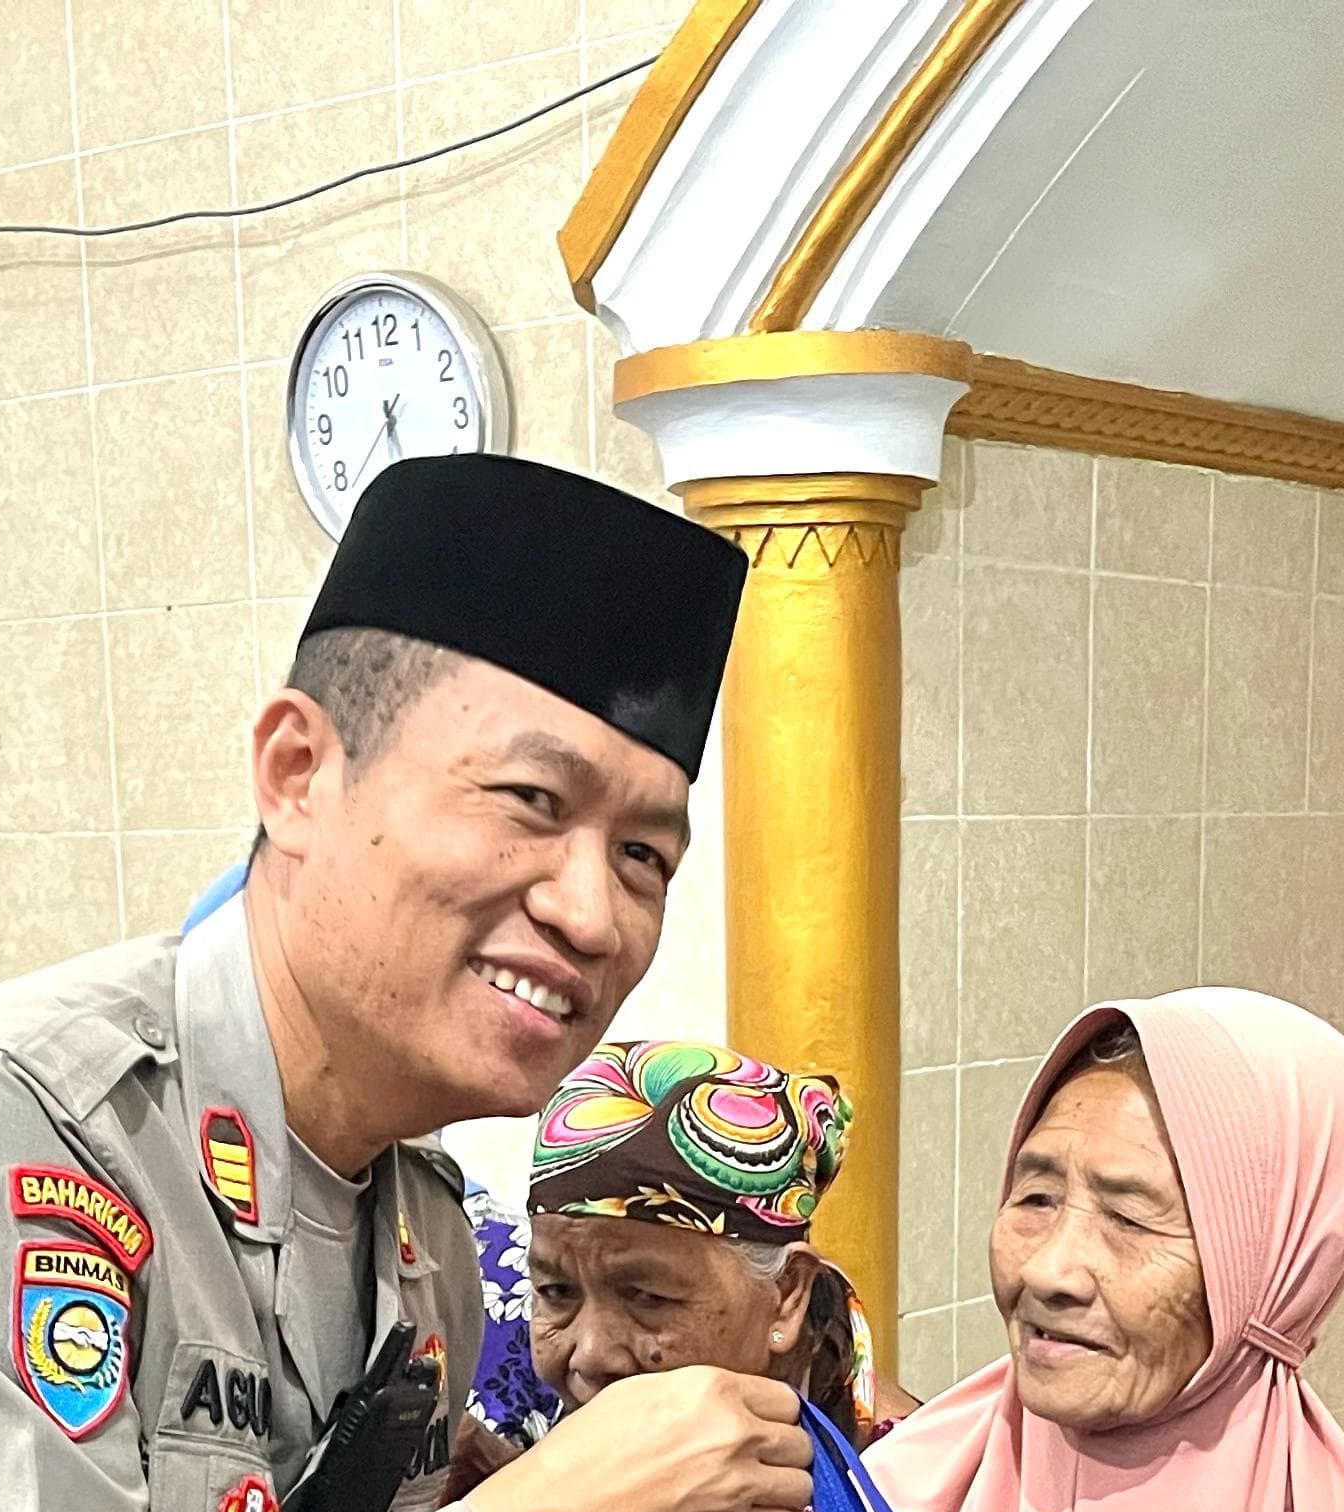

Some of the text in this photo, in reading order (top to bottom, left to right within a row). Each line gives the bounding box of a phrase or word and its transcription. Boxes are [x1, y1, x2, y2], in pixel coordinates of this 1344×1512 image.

[341, 327, 364, 362] 11
[370, 313, 399, 348] 12
[410, 318, 422, 351] 1
[322, 364, 349, 398] 10
[437, 349, 455, 382] 2
[452, 396, 469, 429] 3
[317, 413, 333, 446] 9
[333, 460, 348, 492] 8
[21, 1176, 145, 1255] BAHARKAM
[35, 1254, 124, 1291] BINMAS
